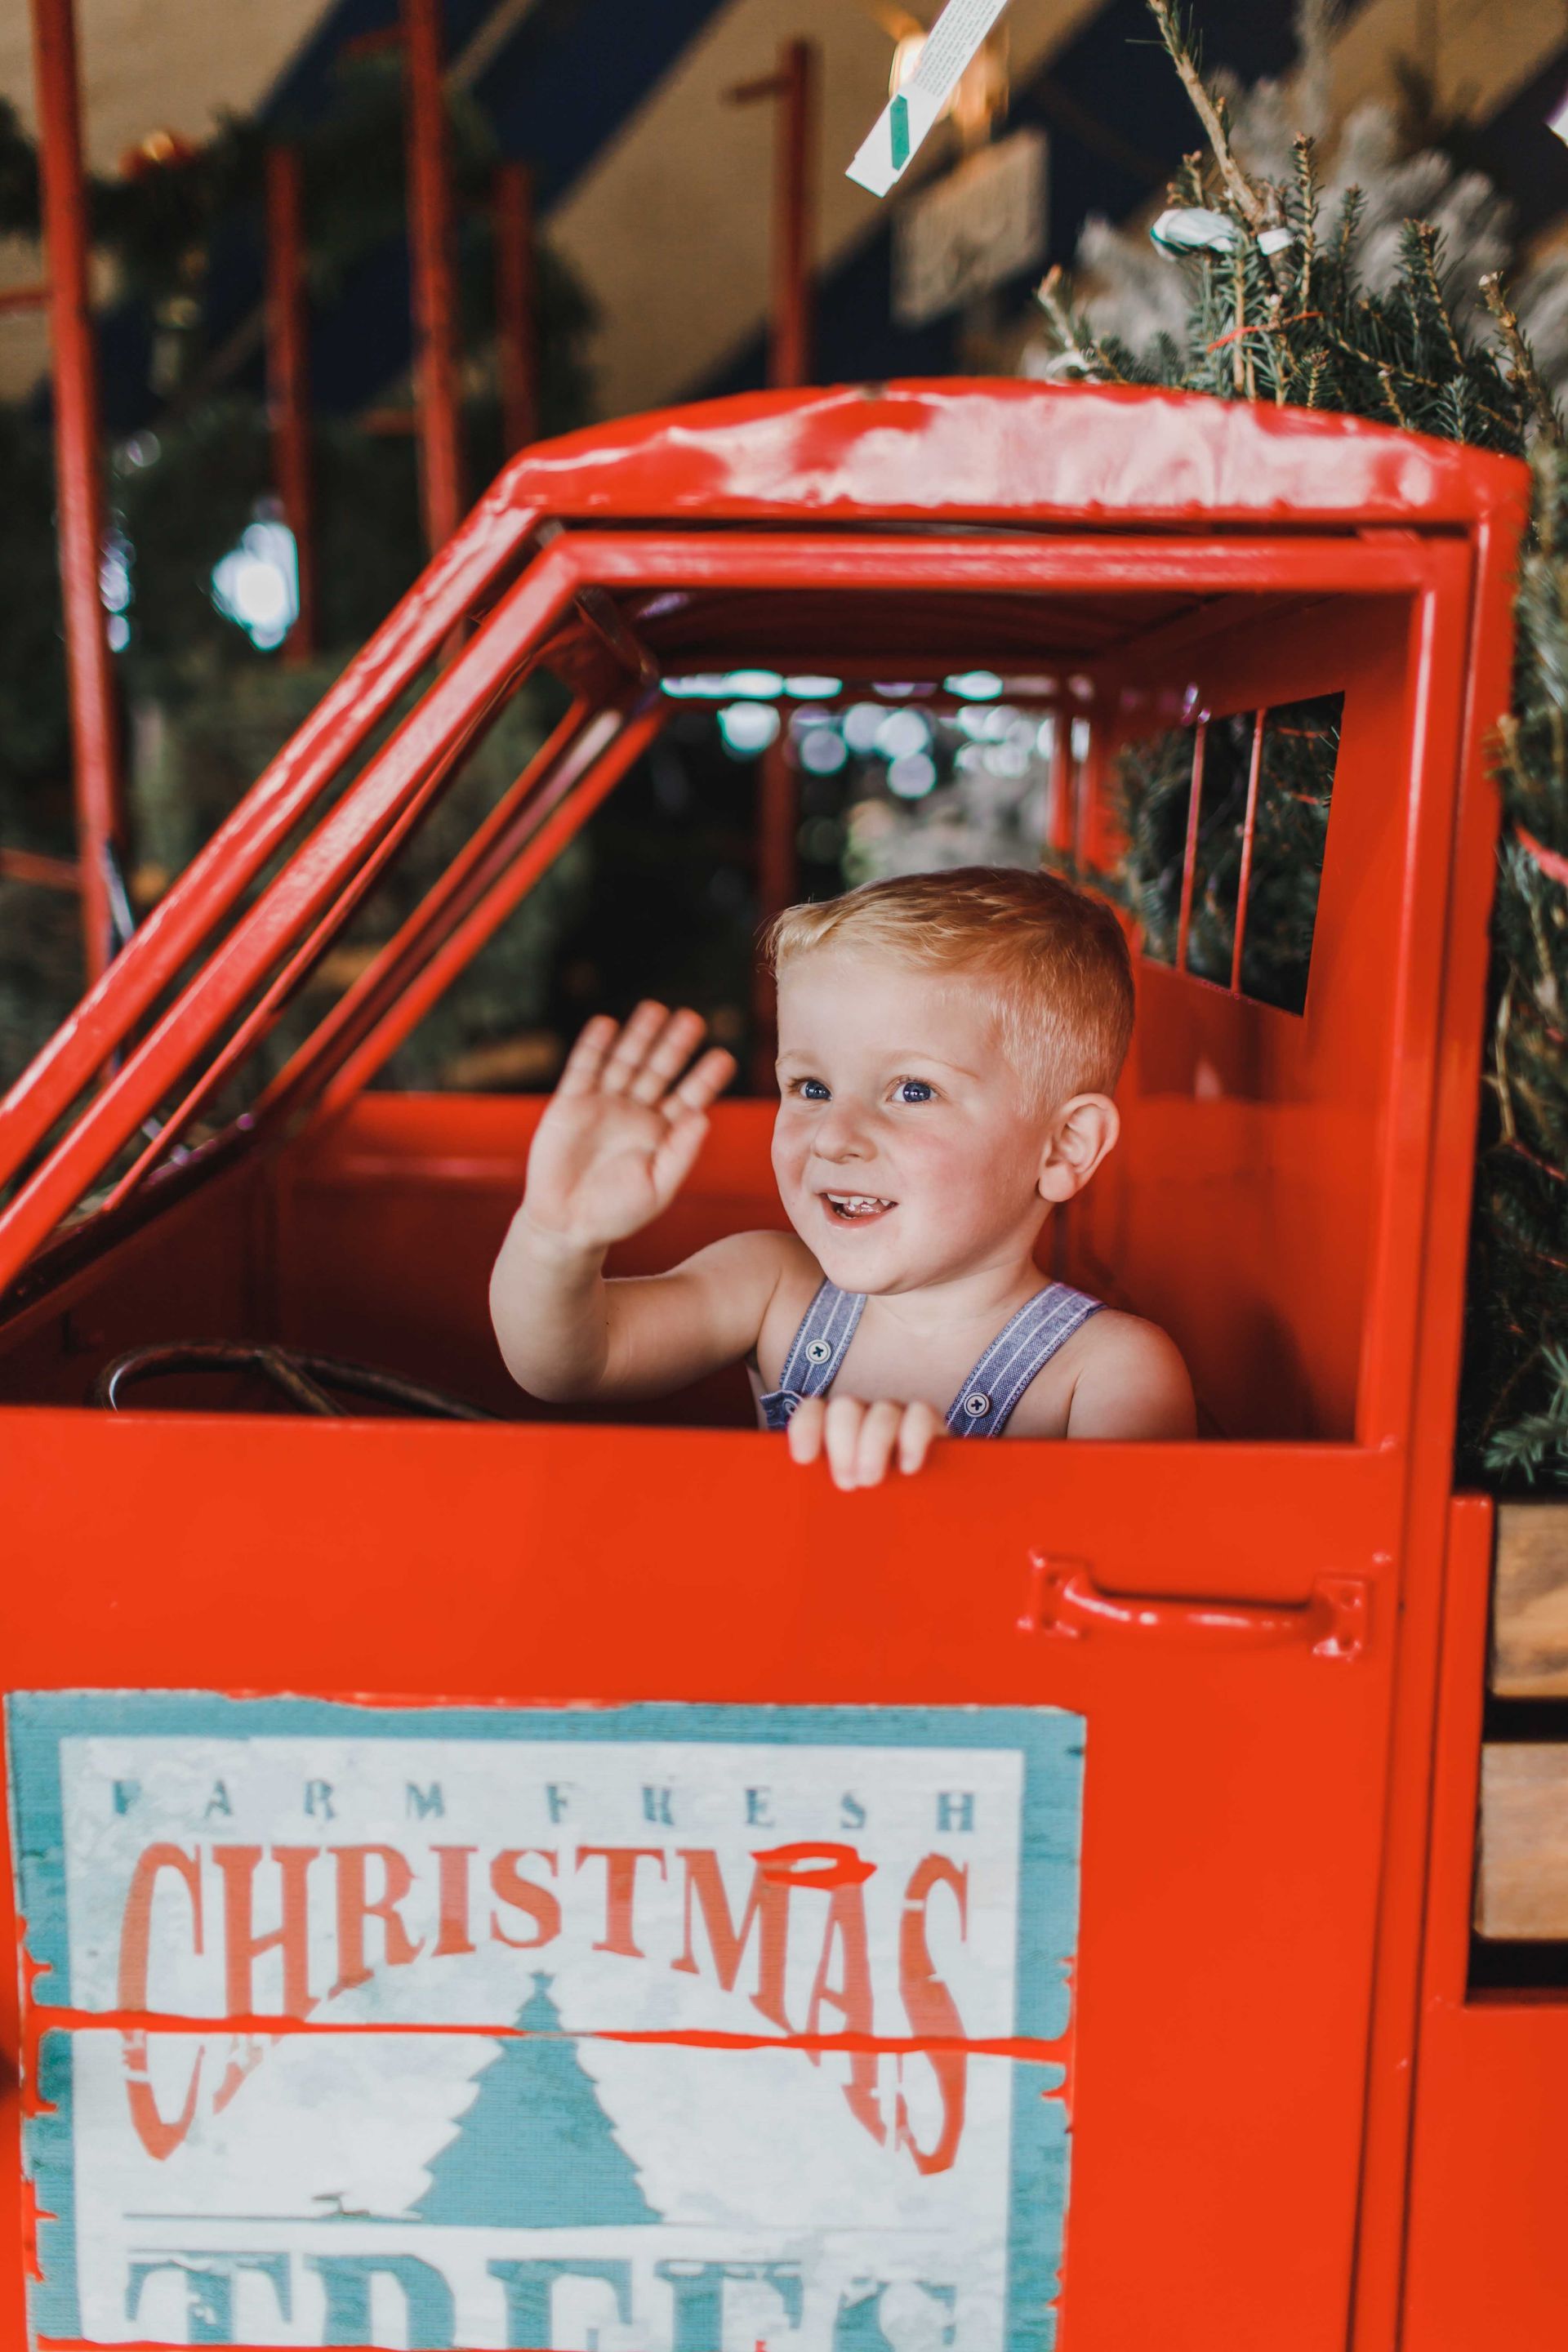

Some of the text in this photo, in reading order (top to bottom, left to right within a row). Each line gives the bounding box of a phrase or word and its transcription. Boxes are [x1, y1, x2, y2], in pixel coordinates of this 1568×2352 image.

[112, 1778, 976, 1832] FARM FRESH
[117, 1841, 969, 2176] CHRISTMAS
